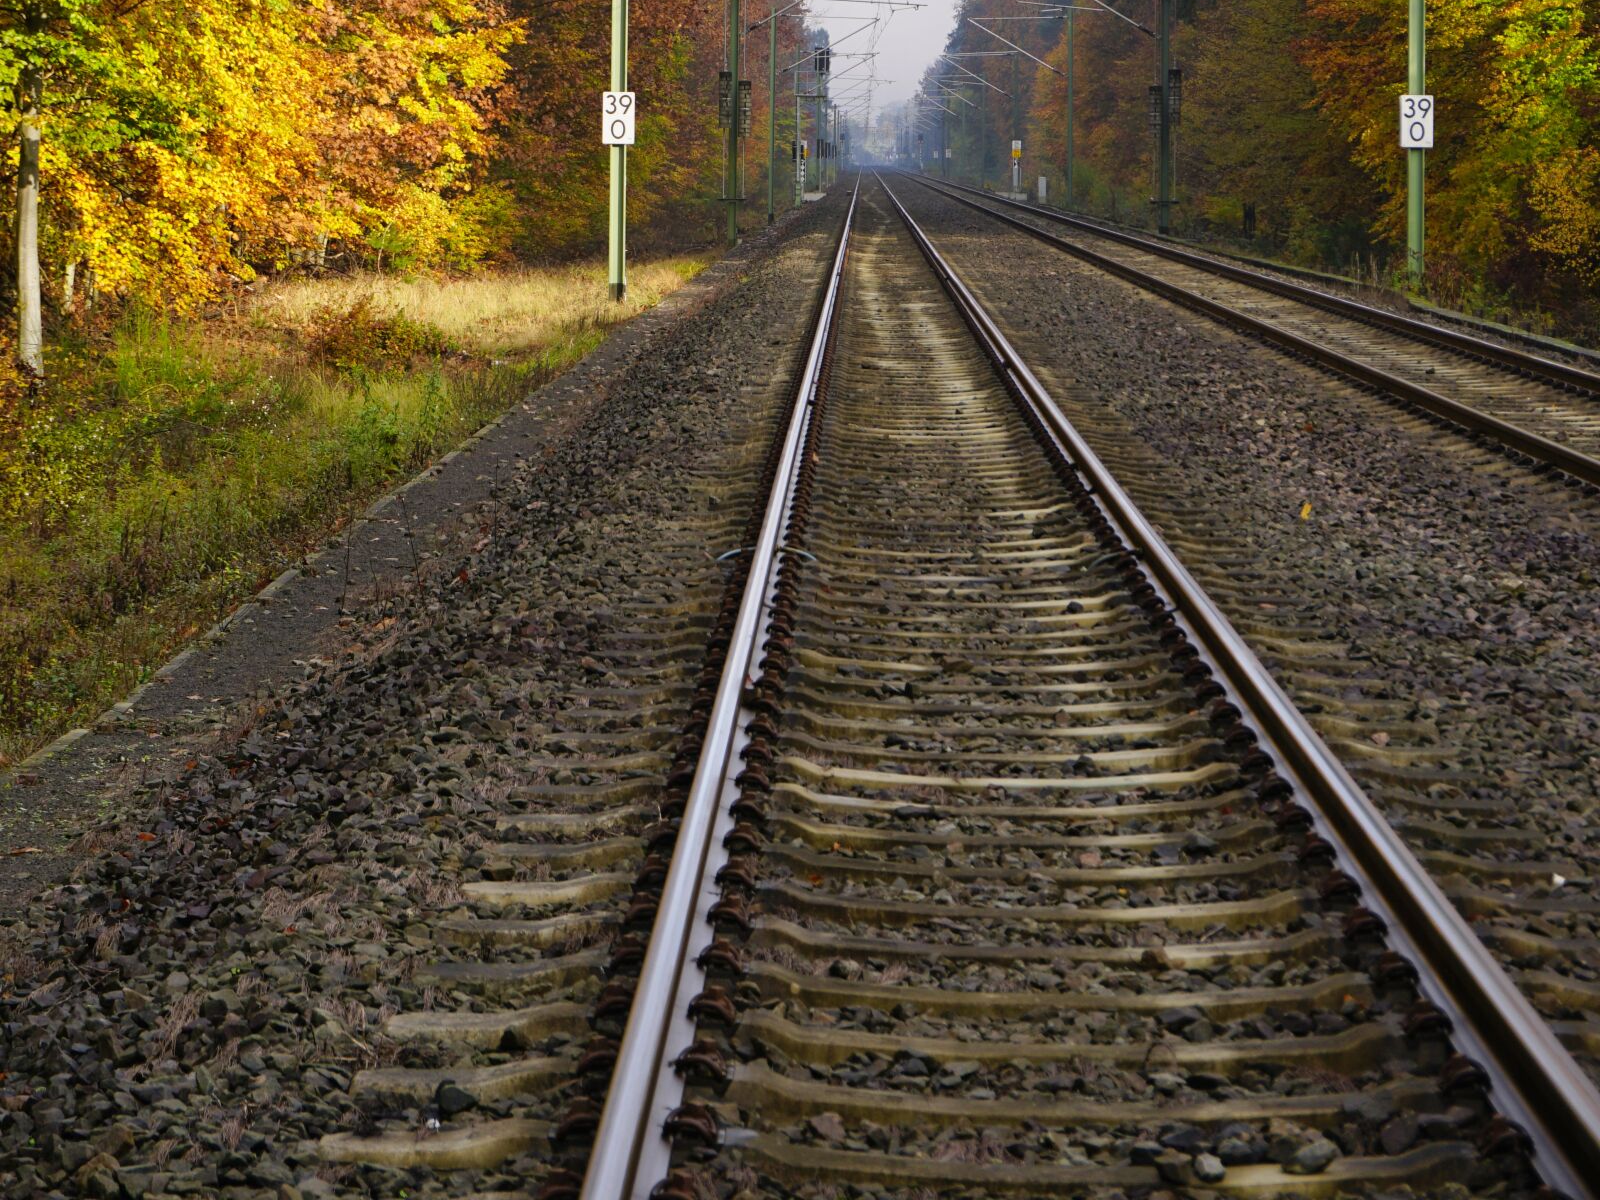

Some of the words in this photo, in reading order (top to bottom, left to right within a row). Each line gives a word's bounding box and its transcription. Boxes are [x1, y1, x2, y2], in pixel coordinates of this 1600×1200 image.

[606, 95, 632, 114] 39
[1404, 99, 1431, 118] 39
[611, 120, 625, 139] 0
[1410, 122, 1424, 141] 0
